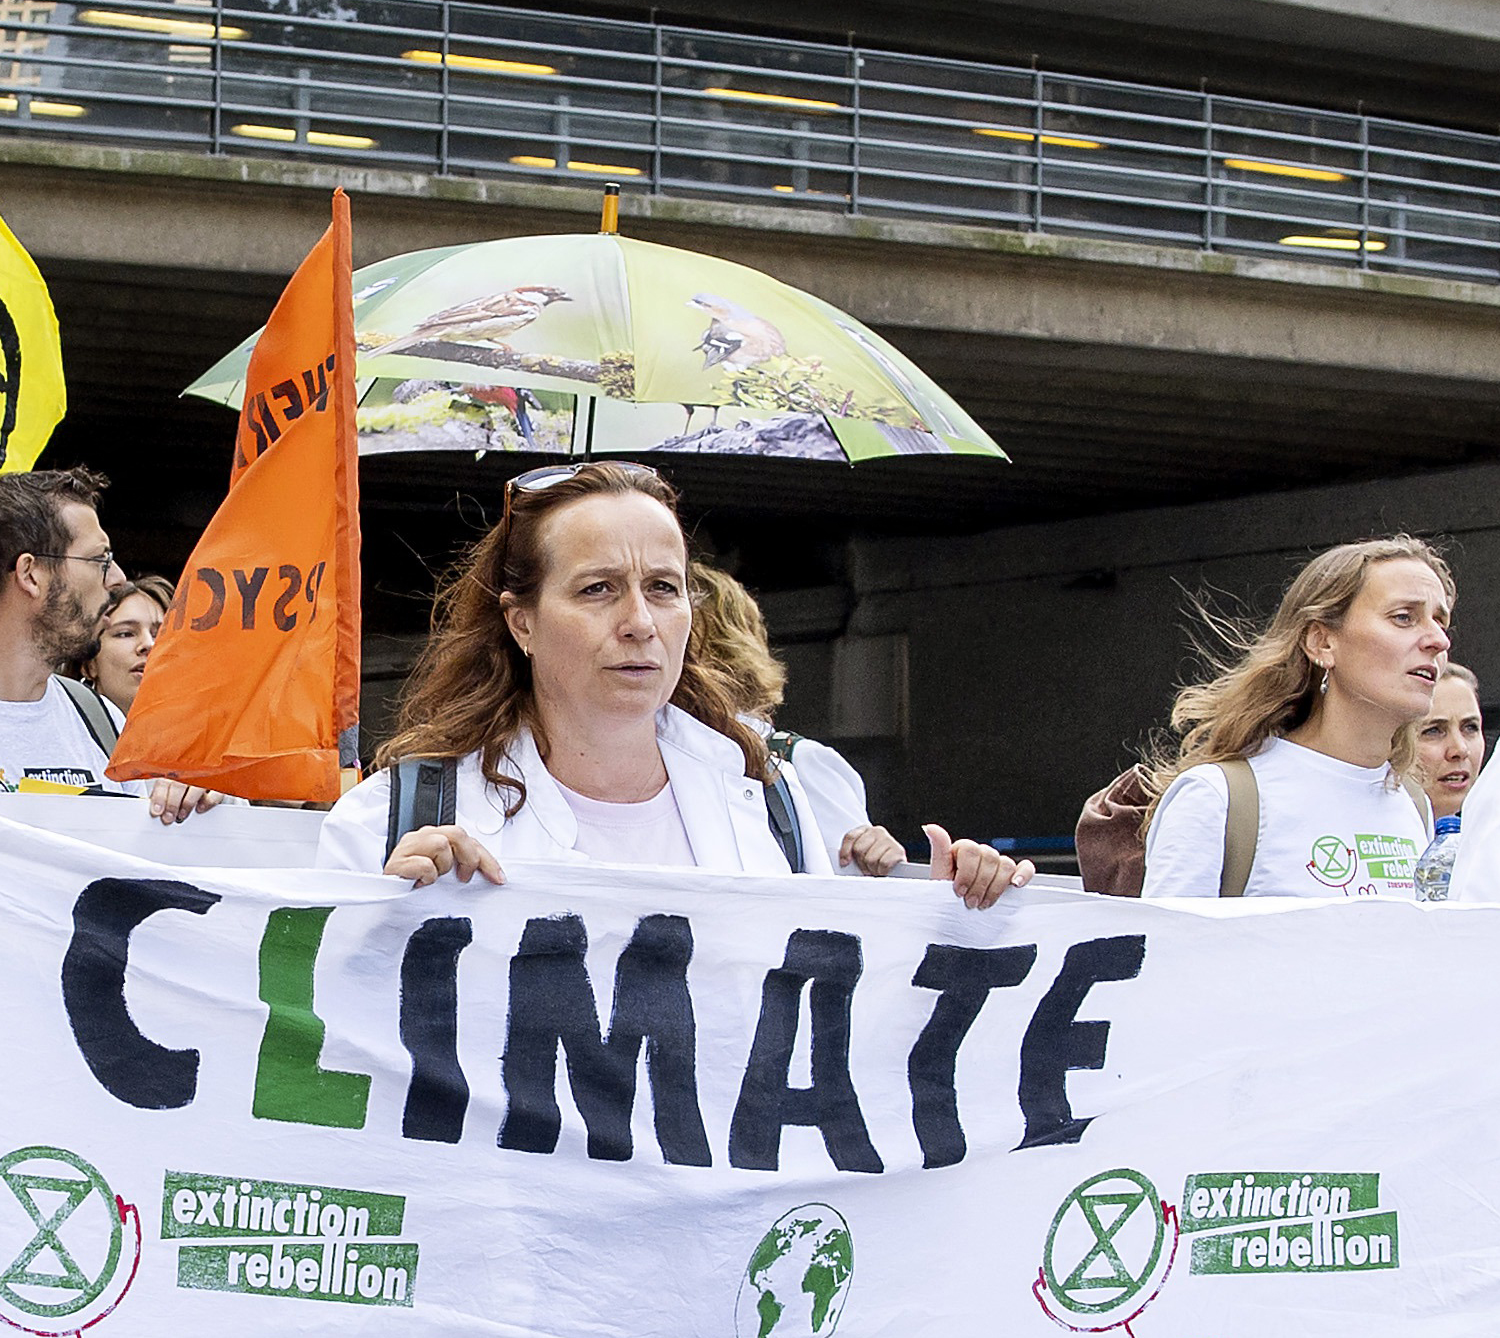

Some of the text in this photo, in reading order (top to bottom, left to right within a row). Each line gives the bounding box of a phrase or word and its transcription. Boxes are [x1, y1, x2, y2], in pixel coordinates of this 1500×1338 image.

[62, 877, 1146, 1174] CLIMATE
[172, 1182, 370, 1237] extinction
[1190, 1175, 1351, 1220] extinction
[227, 1240, 408, 1300] rebellion
[1232, 1218, 1392, 1268] rebellion
